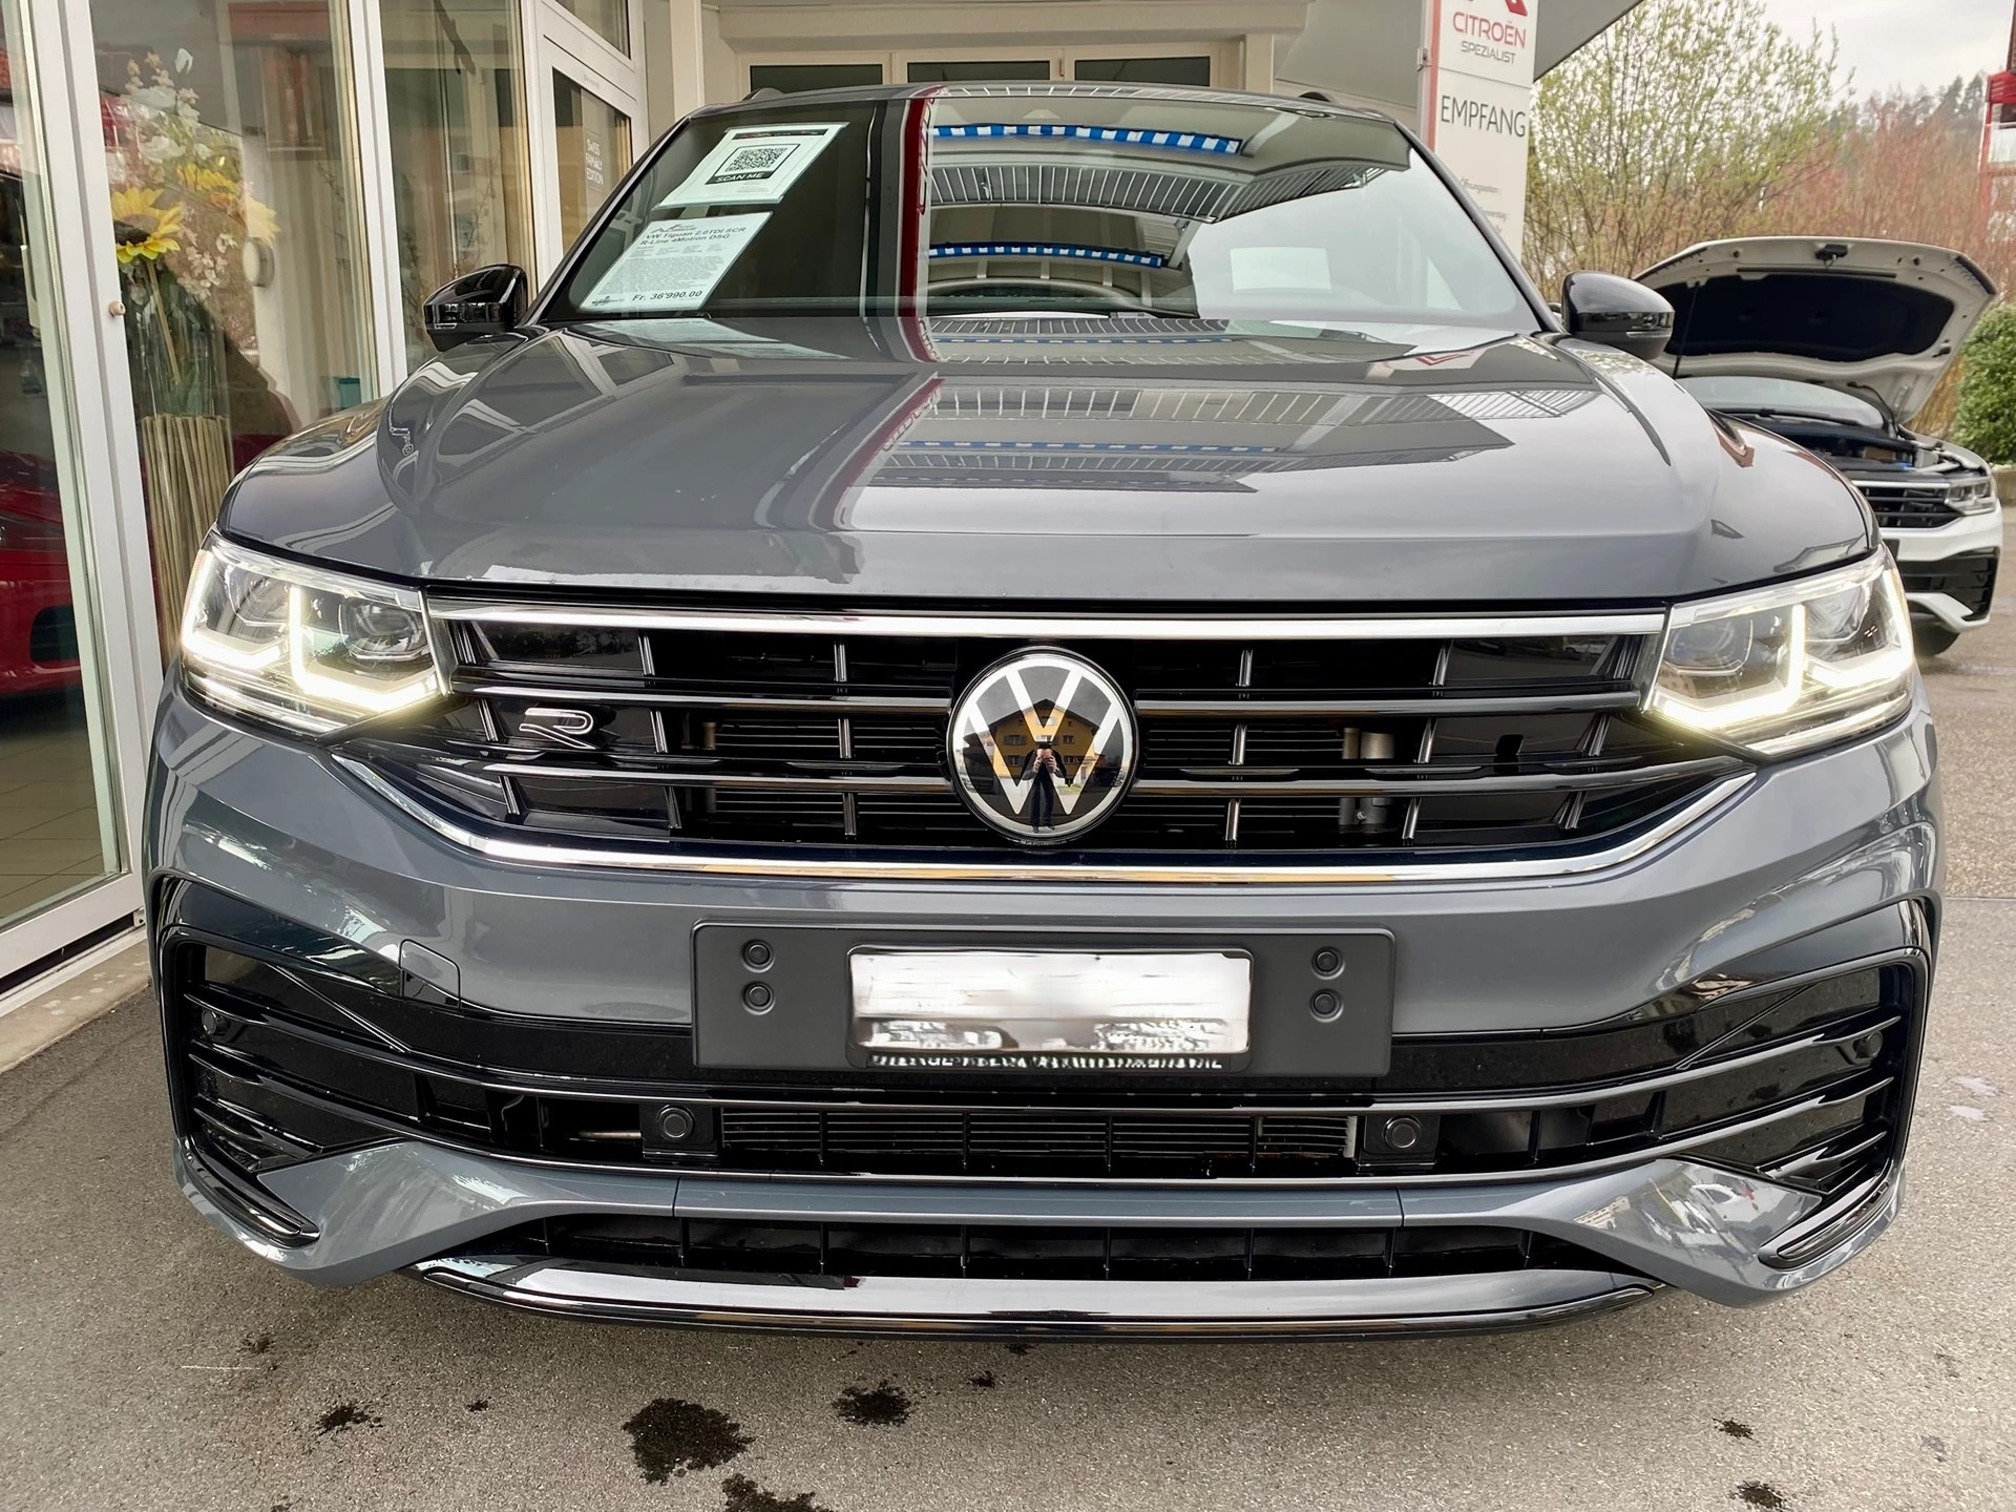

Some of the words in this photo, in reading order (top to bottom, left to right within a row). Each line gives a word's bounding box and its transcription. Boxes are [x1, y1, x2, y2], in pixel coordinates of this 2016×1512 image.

[1453, 11, 1526, 49] CITROËN
[1461, 40, 1516, 64] SPEZIALIST
[1441, 95, 1526, 137] EMPFANG
[715, 173, 745, 183] SCAN
[746, 172, 765, 180] ME
[632, 294, 646, 302] Fr.
[650, 290, 703, 300] 36'990.00
